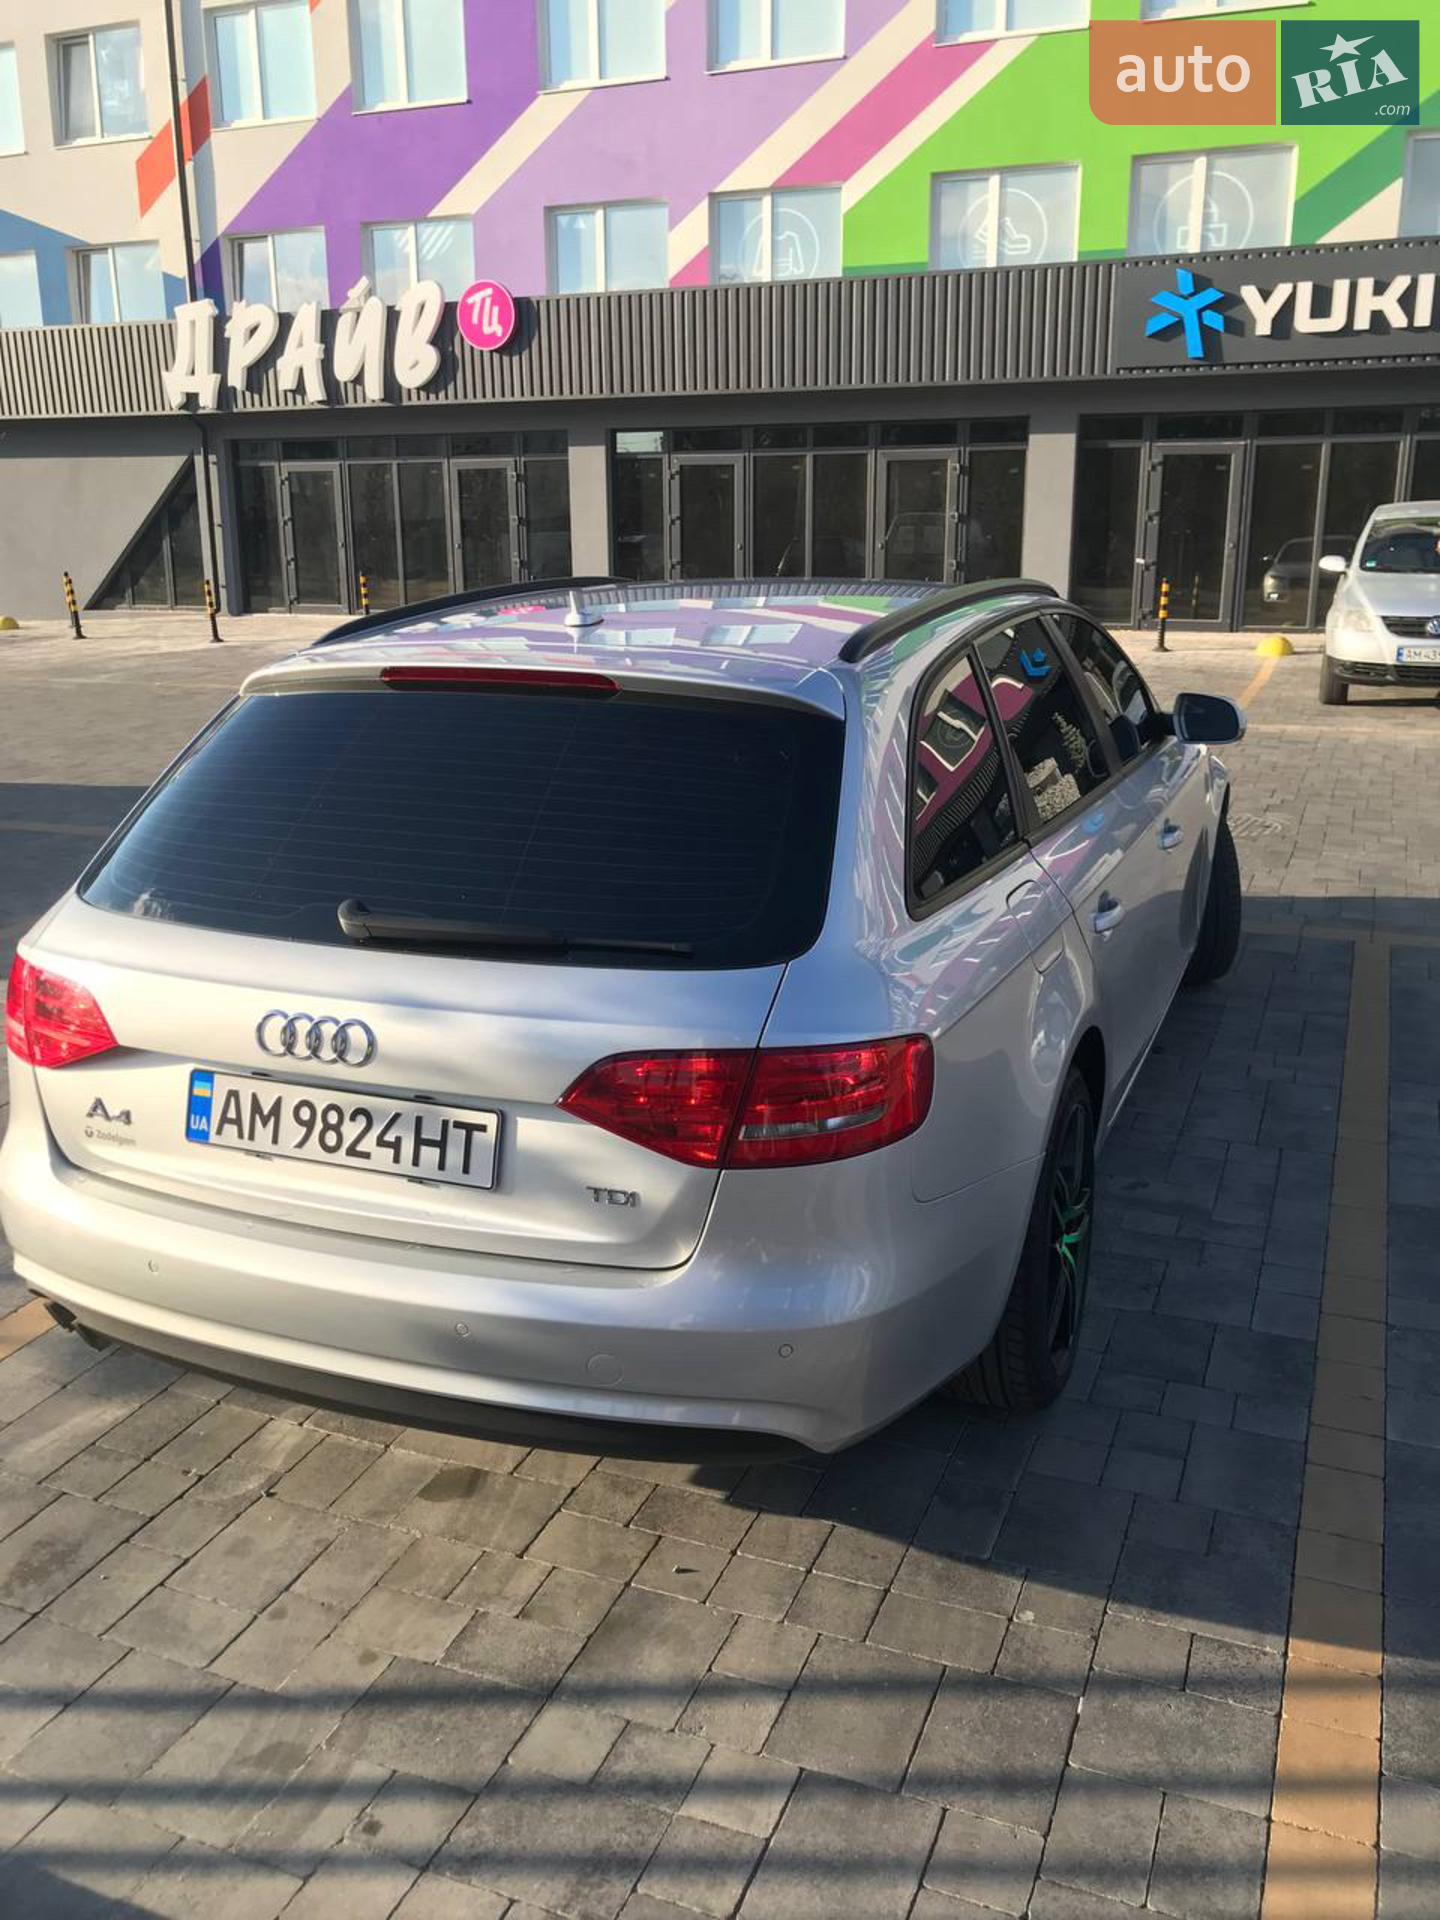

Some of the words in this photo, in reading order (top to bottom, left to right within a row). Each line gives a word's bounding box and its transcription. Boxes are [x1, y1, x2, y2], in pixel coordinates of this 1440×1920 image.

[1240, 273, 1436, 336] YUKI
[161, 275, 445, 410] ДРАЙВ
[466, 287, 503, 337] ТЦ
[85, 1097, 132, 1125] A4
[190, 1114, 208, 1131] UA
[215, 1089, 283, 1145] AM
[292, 1099, 402, 1164] 9824
[411, 1114, 488, 1175] HT
[585, 1186, 641, 1207] TDI
